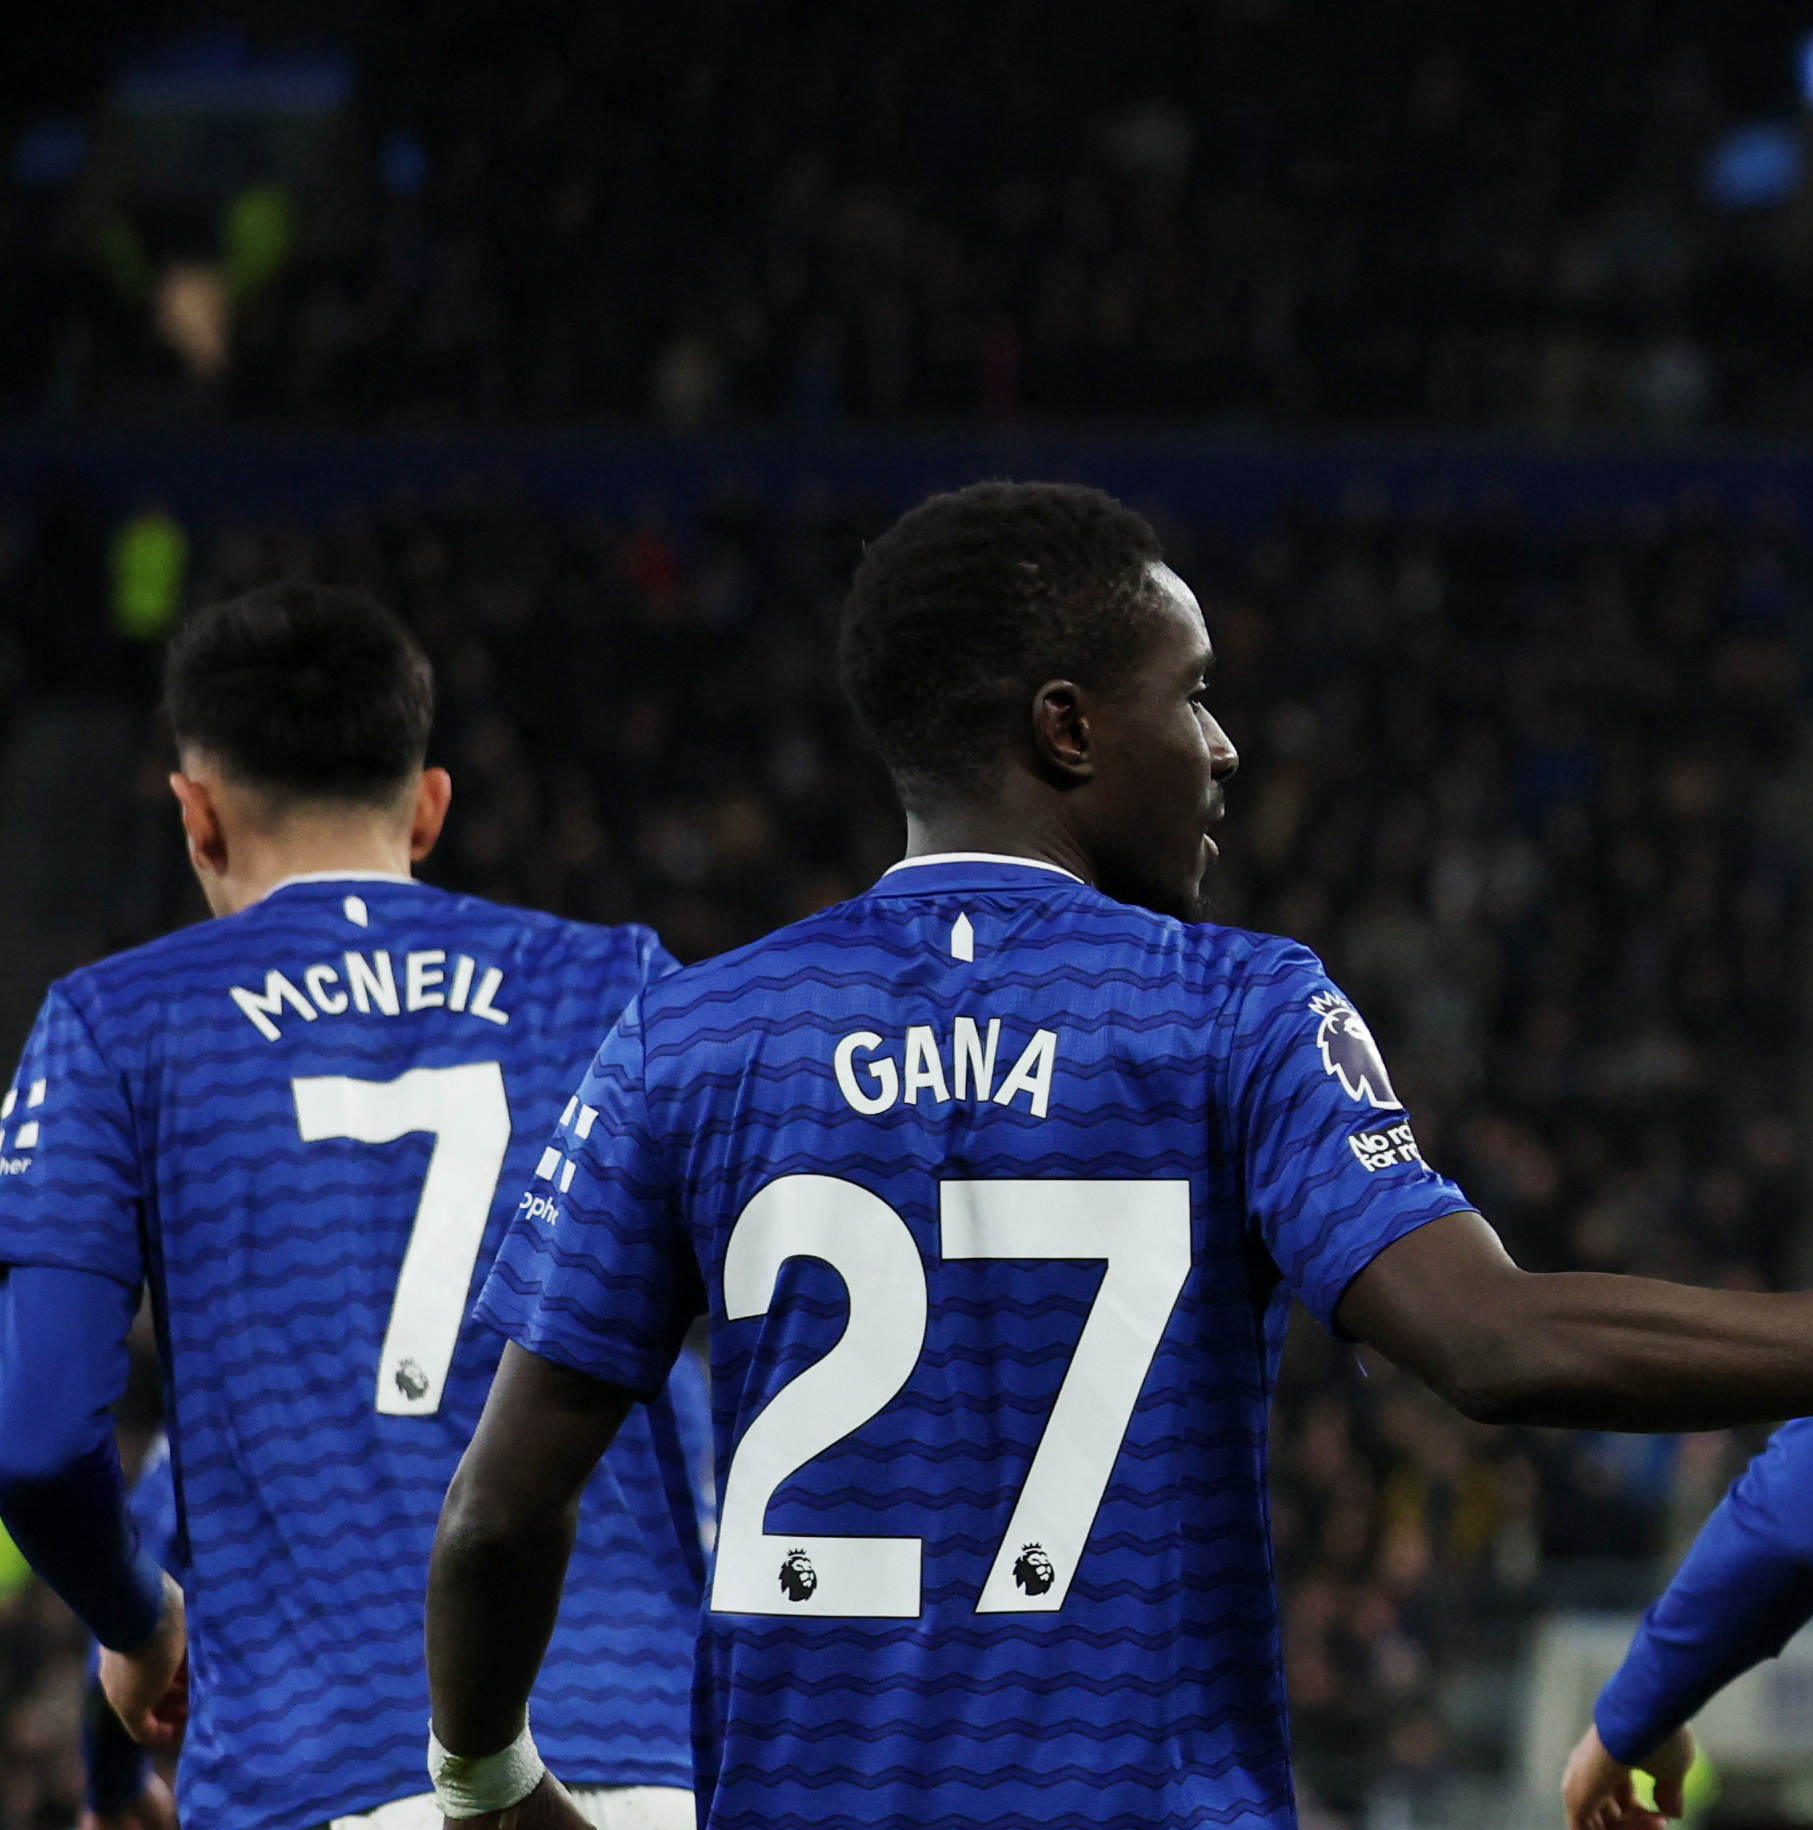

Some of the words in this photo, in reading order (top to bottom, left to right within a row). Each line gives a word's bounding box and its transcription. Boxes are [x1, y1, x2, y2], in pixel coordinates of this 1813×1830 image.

[834, 1016, 1057, 1118] GANA
[1347, 1131, 1389, 1159] No
[1357, 1149, 1399, 1173] for
[291, 1061, 512, 1416] 7
[710, 1173, 1192, 1618] 27
